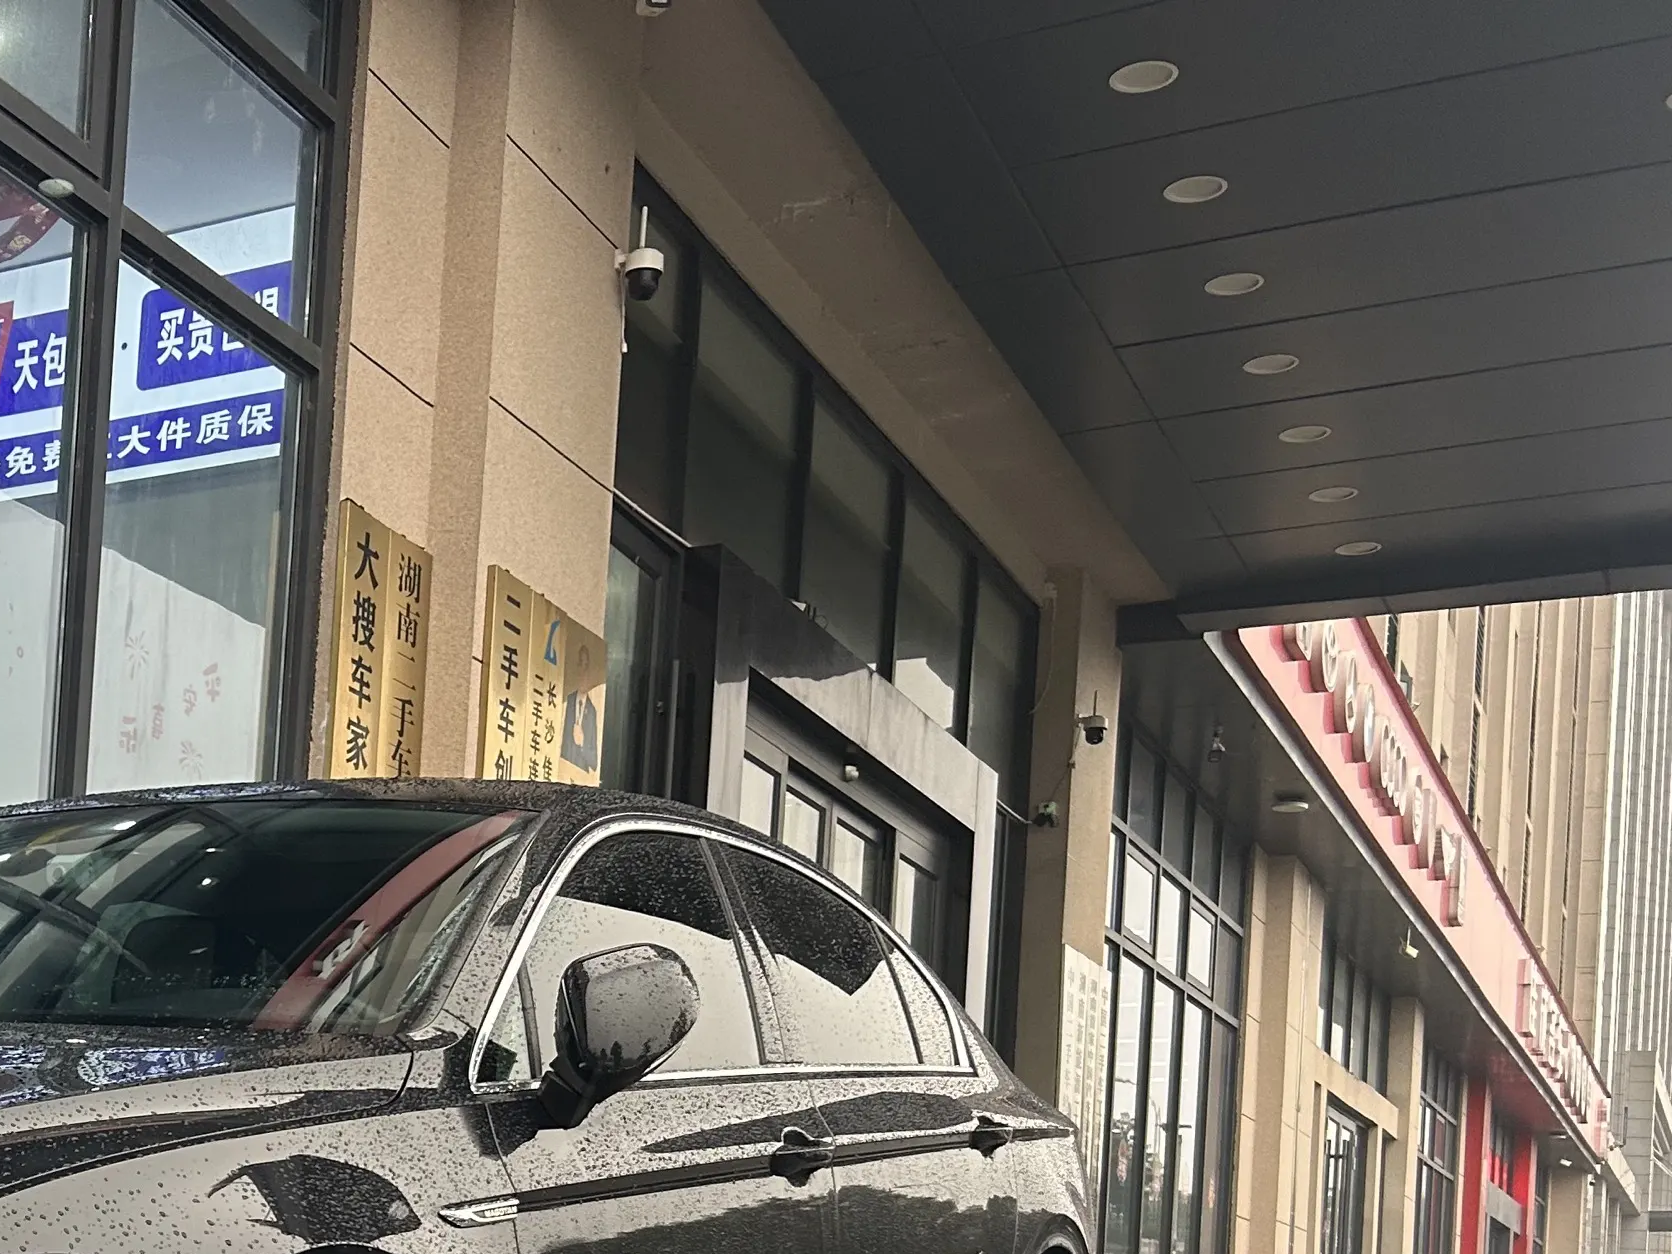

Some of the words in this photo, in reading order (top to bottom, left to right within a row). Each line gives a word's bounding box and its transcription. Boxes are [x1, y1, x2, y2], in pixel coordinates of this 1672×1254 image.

[107, 403, 274, 459] 大件质保
[346, 532, 380, 770] 大搜车家
